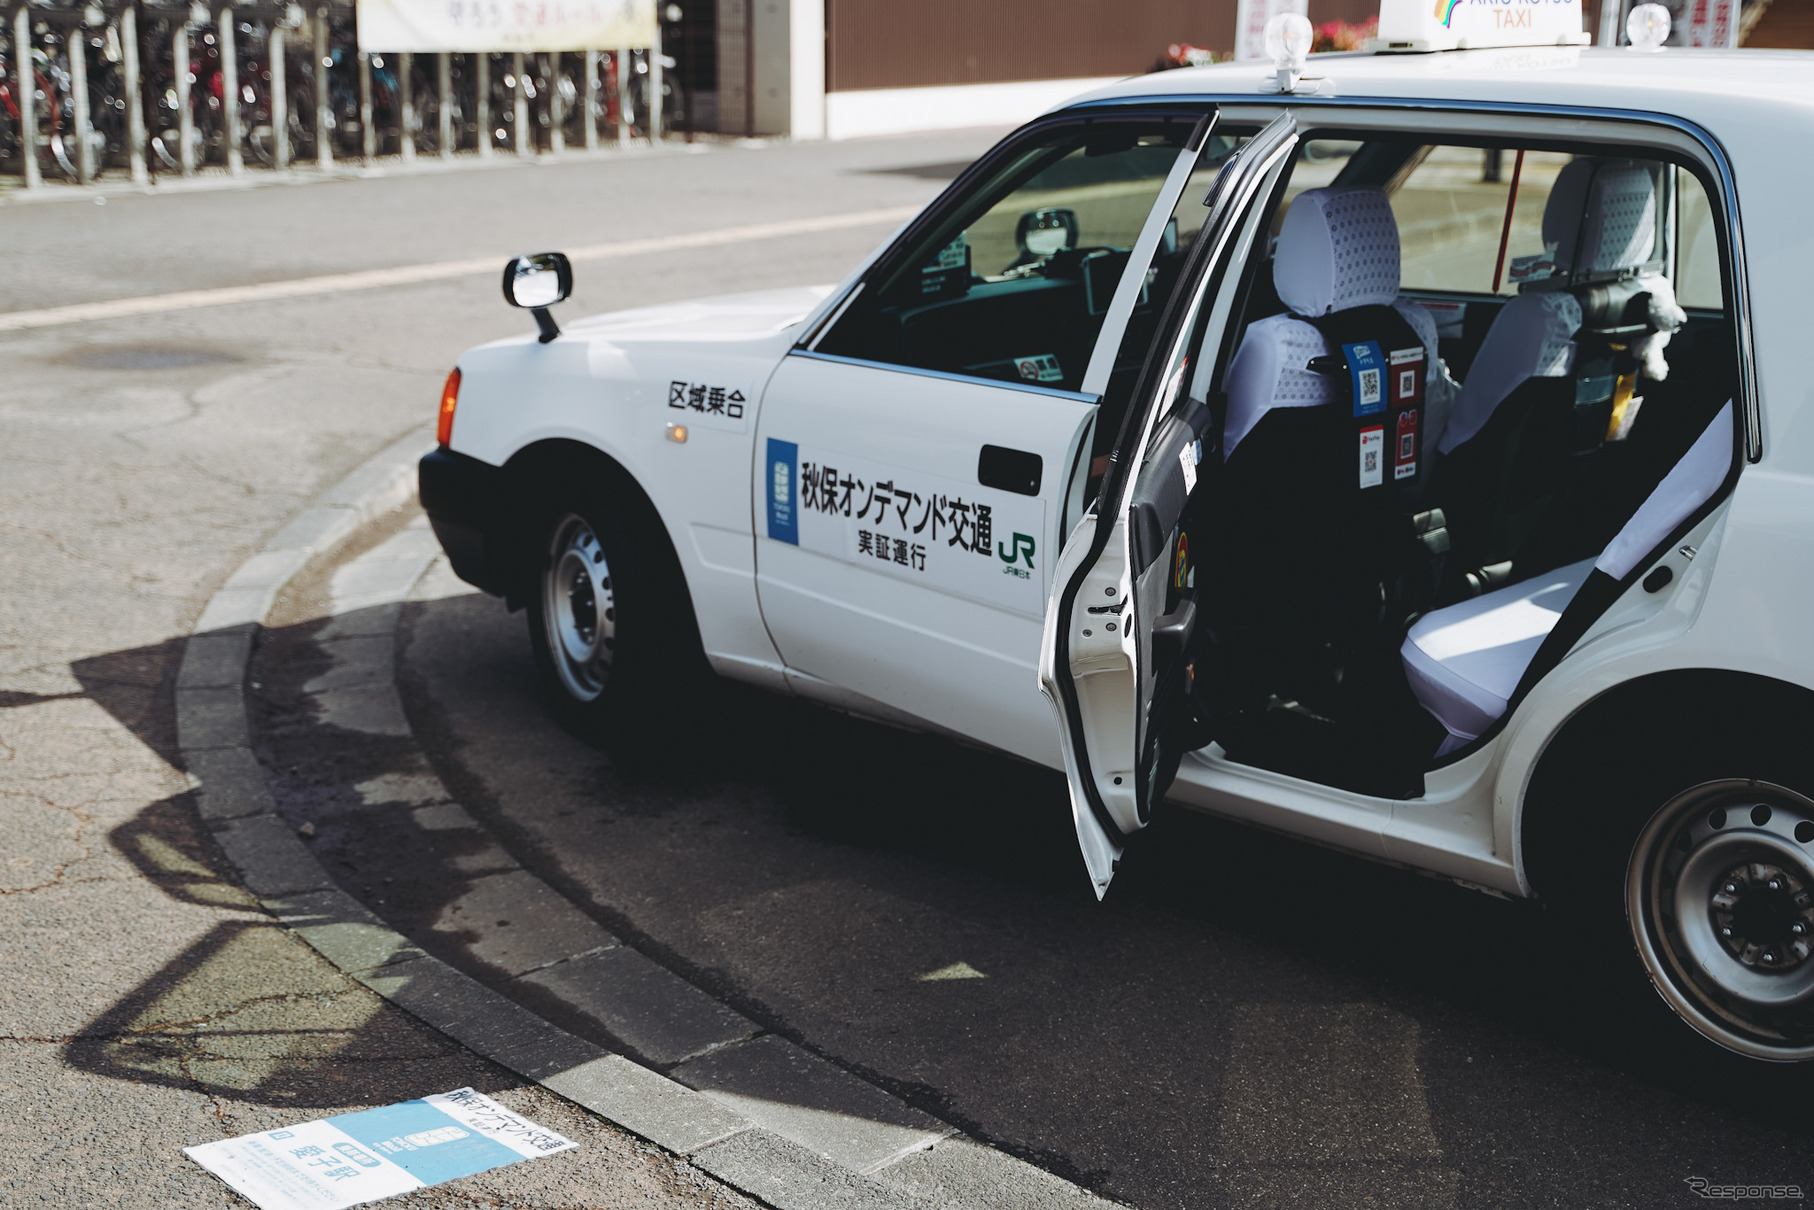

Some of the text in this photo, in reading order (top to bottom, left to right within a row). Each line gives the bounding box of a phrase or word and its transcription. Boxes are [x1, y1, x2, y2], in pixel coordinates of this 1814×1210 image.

[1493, 9, 1532, 28] TAXI
[668, 380, 746, 419] 区域乗合
[800, 461, 993, 557] 秋保オンデマンド交通
[858, 529, 927, 571] 実証運行
[998, 532, 1036, 569] JR
[288, 1145, 362, 1182] 愛子駅
